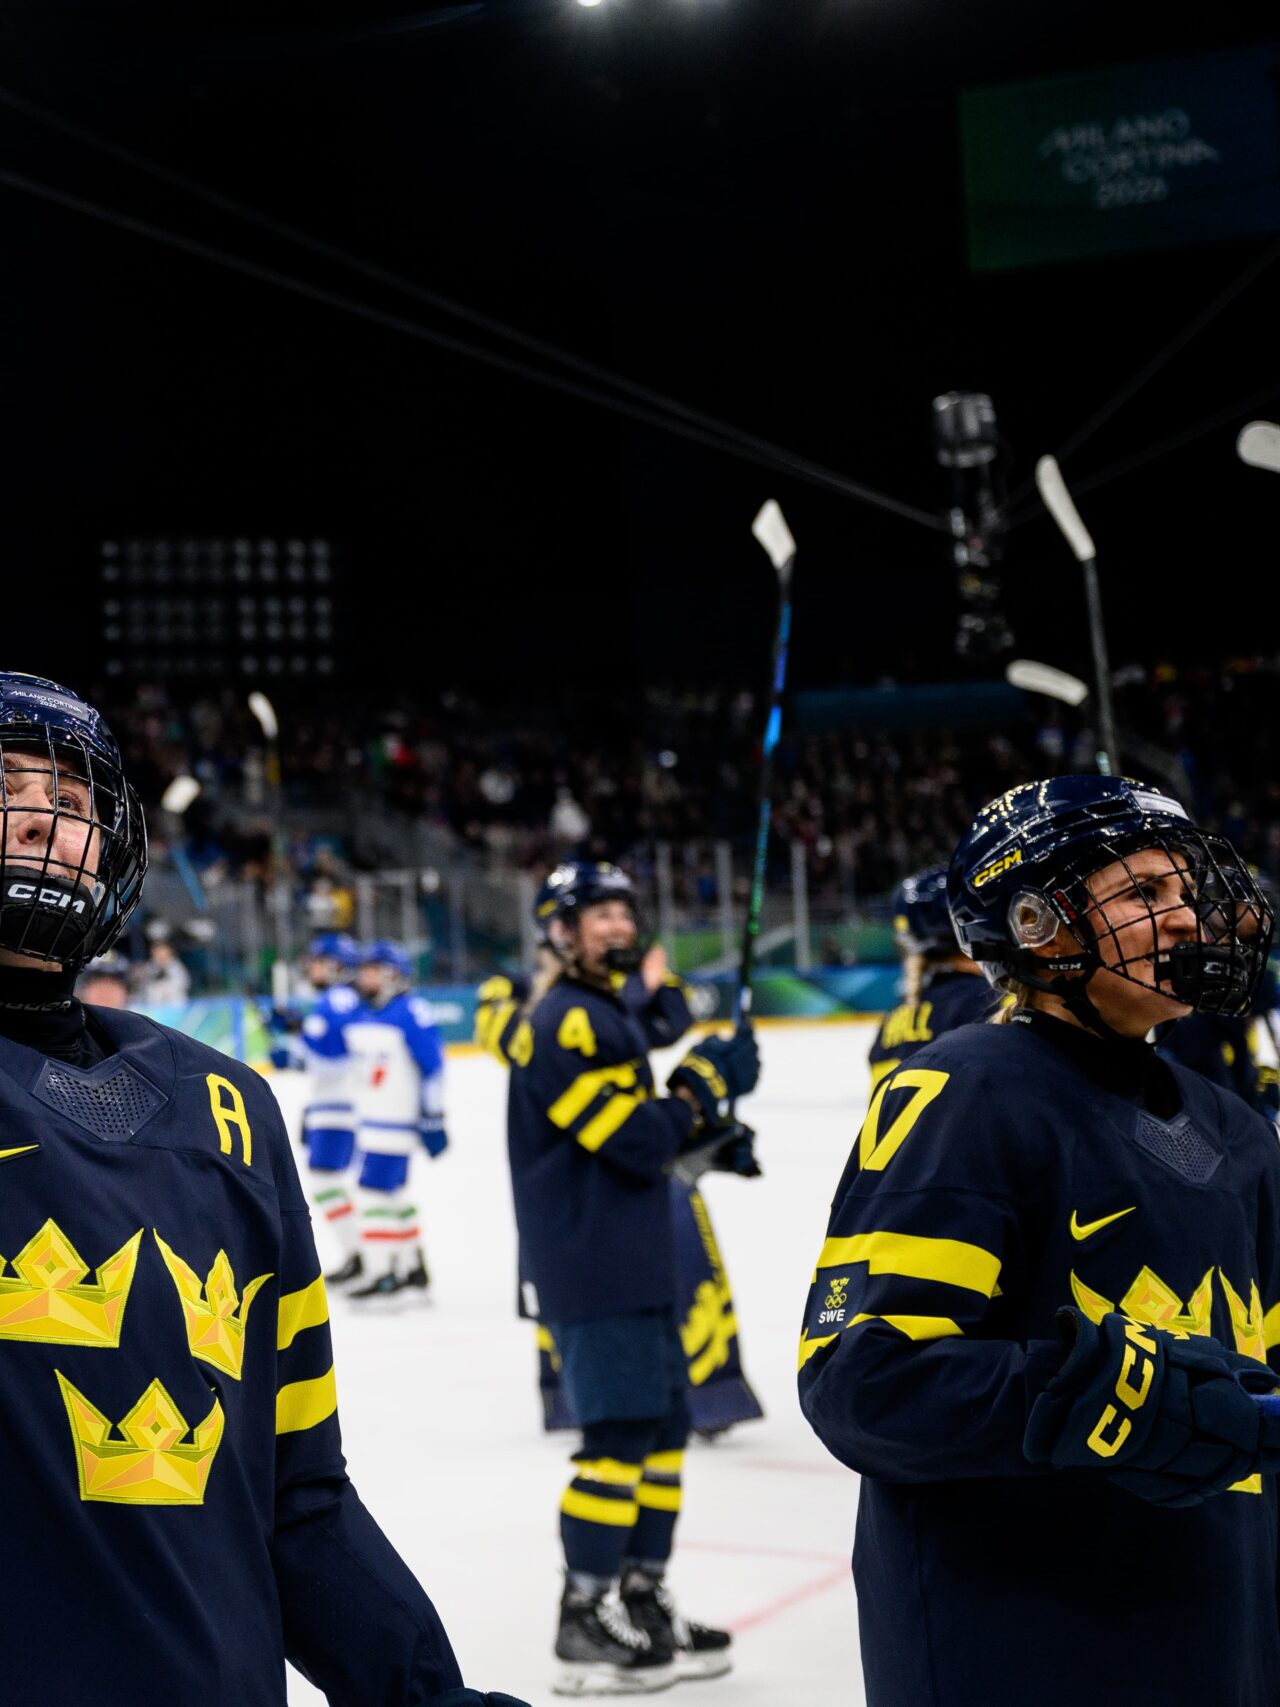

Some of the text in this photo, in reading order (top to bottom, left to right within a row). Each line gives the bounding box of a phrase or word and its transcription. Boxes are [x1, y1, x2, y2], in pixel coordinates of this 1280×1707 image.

[1037, 108, 1191, 160] MILANO
[1060, 137, 1221, 184] CORTINA
[10, 690, 83, 713] MILANO CORTINA
[39, 700, 57, 709] 2026
[972, 848, 1022, 888] CCM
[7, 883, 86, 914] CCM
[1048, 961, 1082, 971] CCM
[556, 1005, 598, 1058] 4
[205, 1072, 252, 1167] A
[858, 1068, 950, 1171] 17
[818, 1309, 846, 1324] SWE
[1086, 1314, 1158, 1458] CCM
